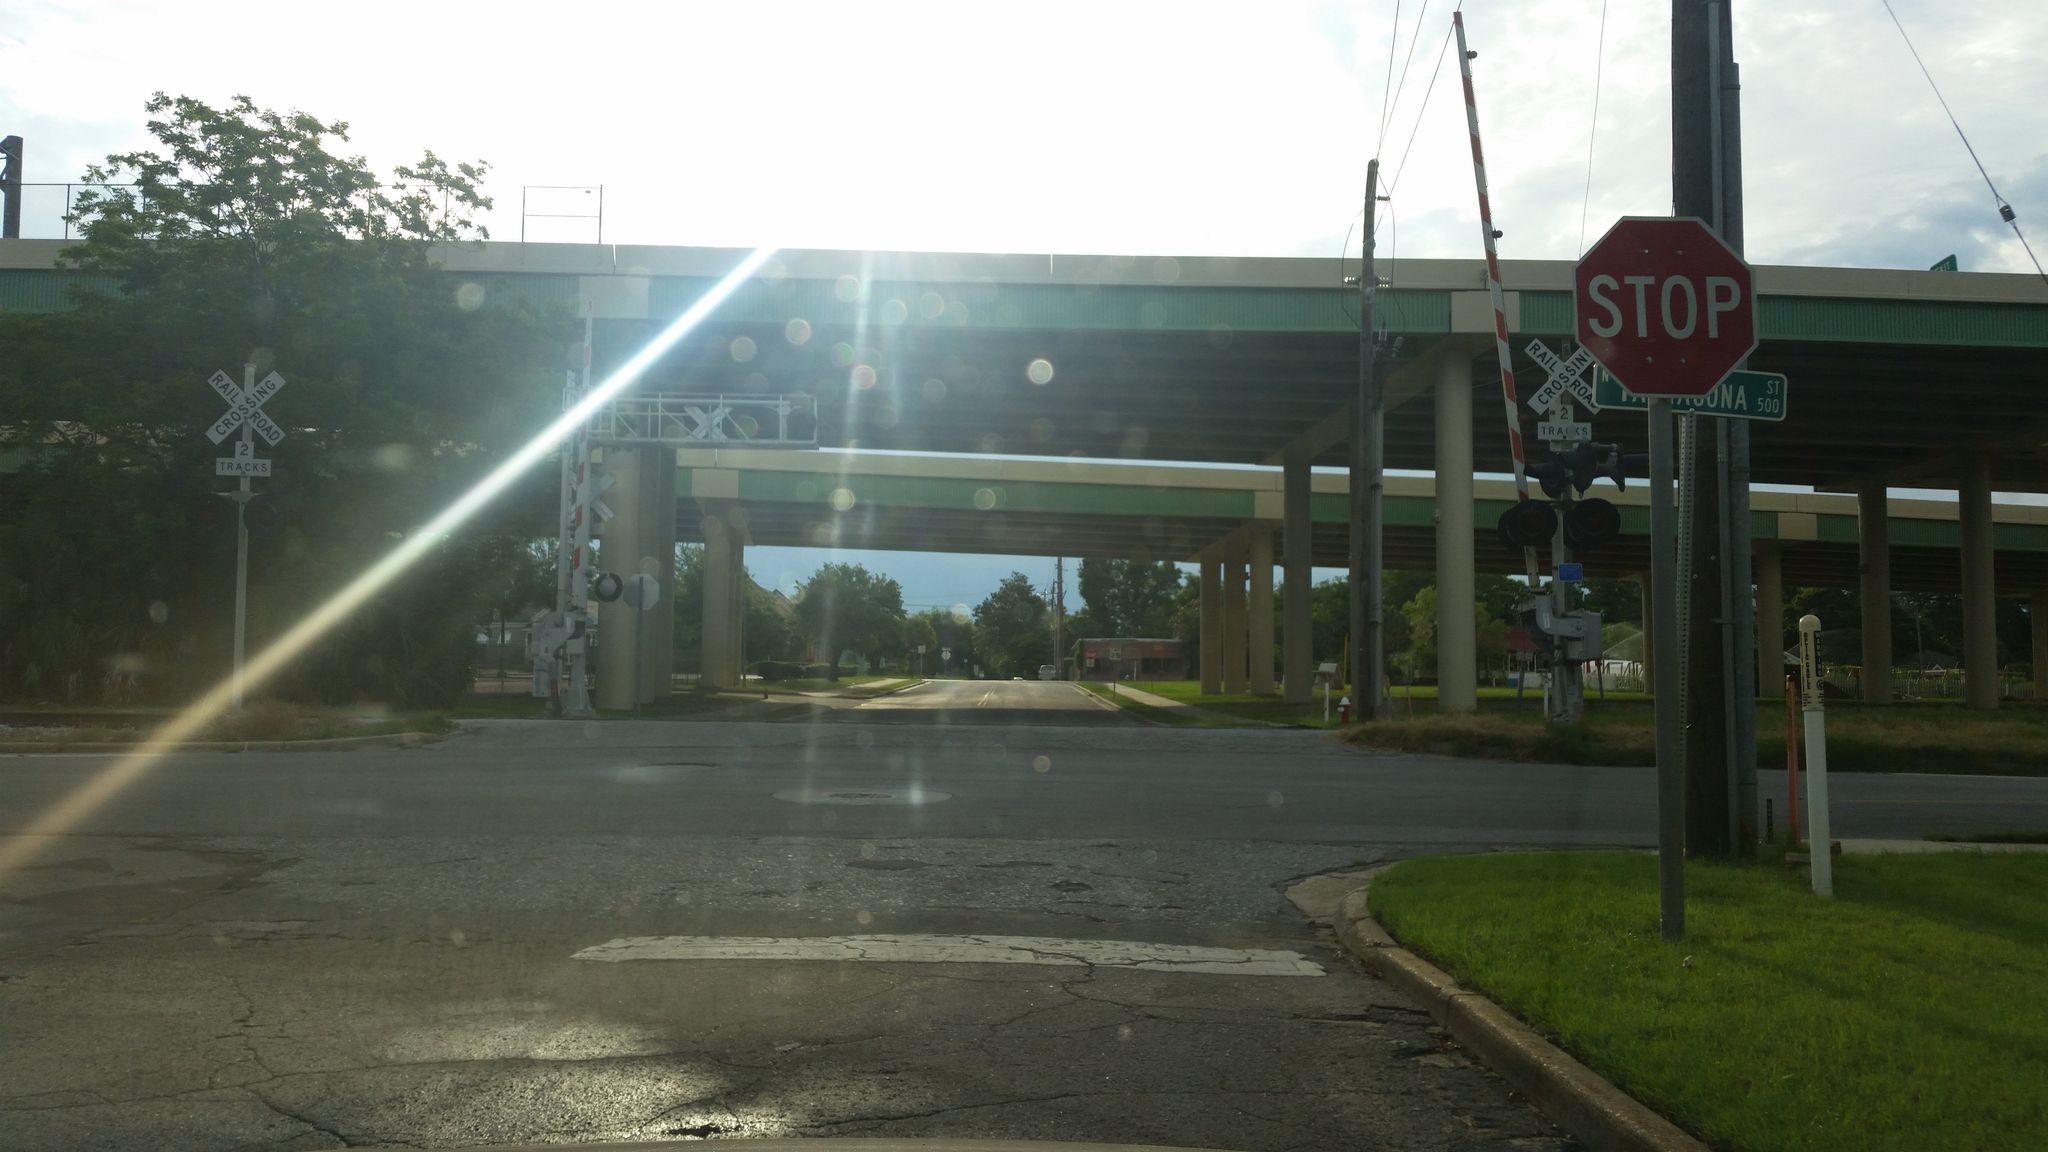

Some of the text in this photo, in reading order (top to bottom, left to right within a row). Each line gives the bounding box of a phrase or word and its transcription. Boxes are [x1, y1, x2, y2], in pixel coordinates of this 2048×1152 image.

[1588, 274, 1741, 339] STOP
[1529, 343, 1558, 372] RAIL
[1538, 349, 1591, 405] CROSSIN
[1602, 368, 1609, 382] N
[1767, 380, 1781, 395] ST
[212, 374, 281, 441] RAIL ROAD
[215, 379, 276, 436] CROSSING
[1757, 397, 1780, 413] 500
[1560, 407, 1569, 420] 2
[1542, 426, 1588, 435] TRACKS
[240, 444, 249, 456] 2
[220, 462, 268, 472] TRACKS
